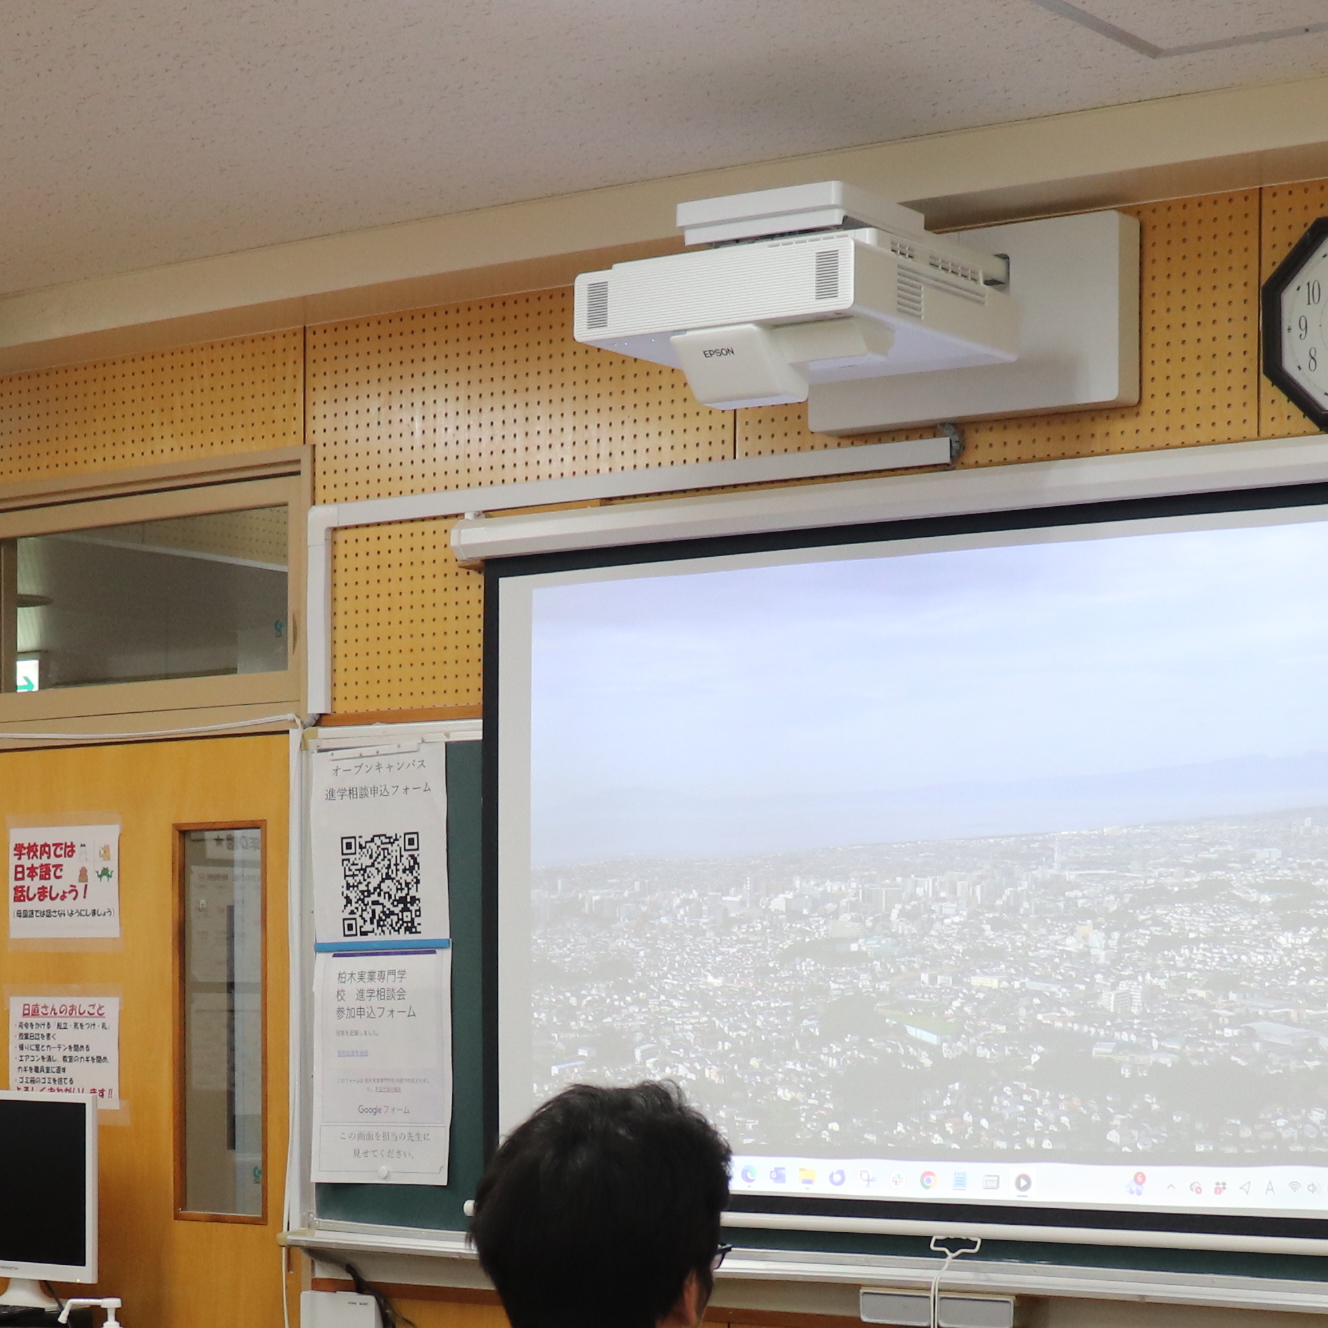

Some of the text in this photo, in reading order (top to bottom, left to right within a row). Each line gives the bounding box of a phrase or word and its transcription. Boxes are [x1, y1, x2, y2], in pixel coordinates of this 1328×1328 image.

[1306, 280, 1321, 306] 10
[1298, 315, 1308, 340] 9
[703, 347, 735, 358] EPSON
[1308, 347, 1317, 372] 8
[332, 759, 426, 776] オープンキャンパス
[325, 782, 431, 801] 進学相談申込フォーム
[14, 842, 76, 860] 学校内では
[14, 864, 63, 881] 日本語で
[338, 969, 407, 984] 柏木実業専門学
[336, 987, 407, 1002] 校 進学相談会
[22, 1004, 105, 1016] 日直さんのおしごと
[336, 1005, 416, 1020] 参加申込フォーム
[358, 1105, 410, 1116] Google フォーム
[340, 1132, 430, 1142] この画面を担当の先生に
[353, 1149, 415, 1159] 見せてください。
